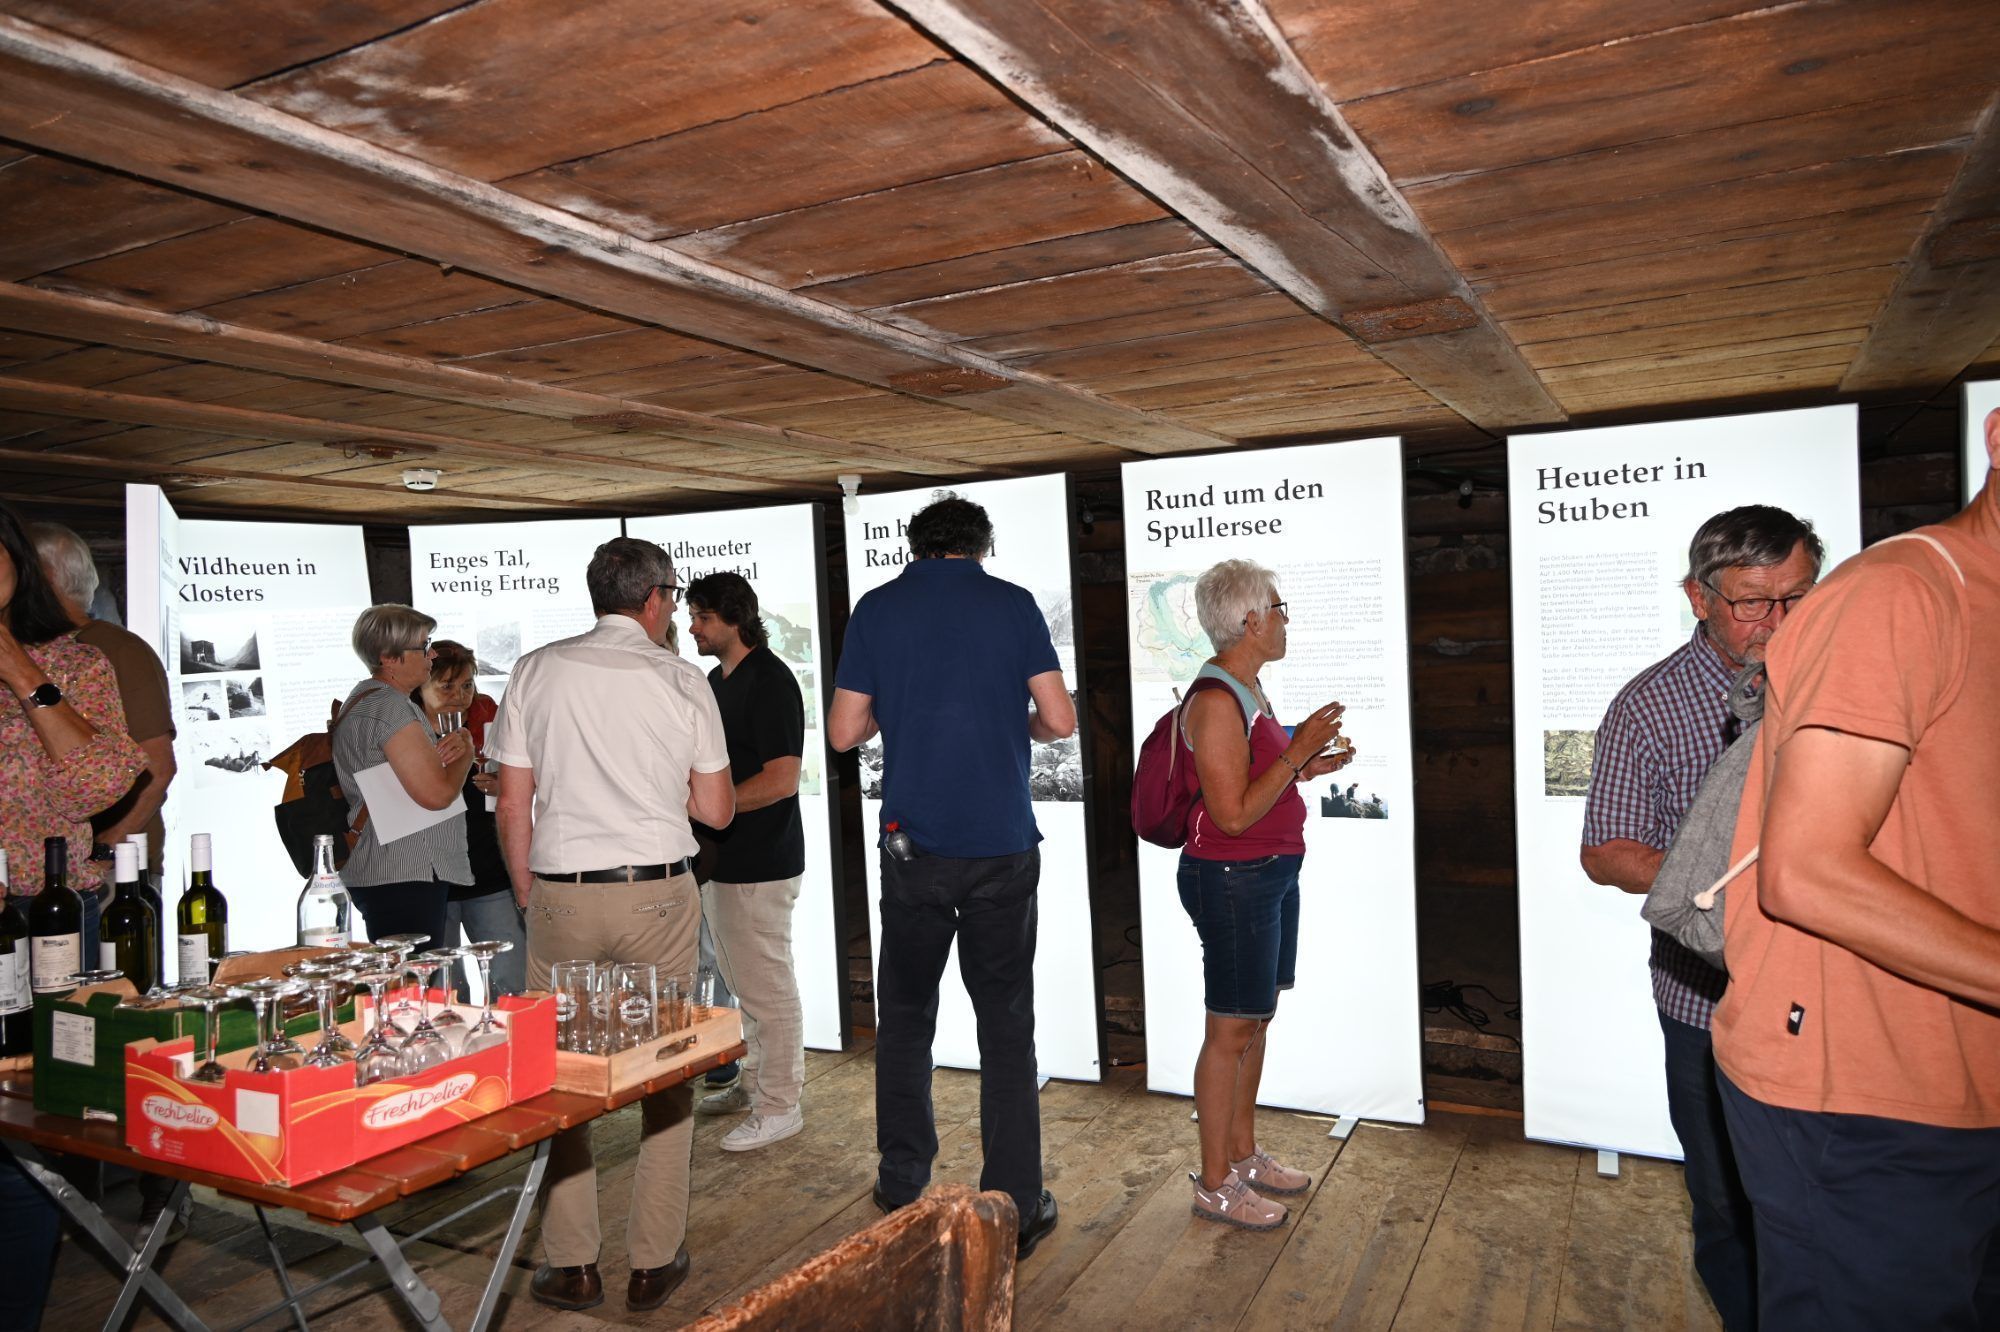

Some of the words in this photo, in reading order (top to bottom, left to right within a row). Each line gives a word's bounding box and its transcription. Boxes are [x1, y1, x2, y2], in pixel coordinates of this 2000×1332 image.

[1536, 463, 1664, 490] Heueter
[1674, 456, 1708, 480] in
[1146, 485, 1215, 511] Rund
[1223, 487, 1266, 505] um
[1274, 478, 1325, 501] den
[1538, 497, 1650, 524] Stuben
[863, 522, 890, 540] Im
[1147, 516, 1282, 547] Spullersee
[430, 552, 488, 573] Enges
[494, 549, 530, 568] Tal,
[657, 540, 752, 559] ldheueter
[296, 558, 317, 575] in
[431, 575, 493, 597] wenig
[499, 574, 560, 595] Ertrag
[144, 1098, 214, 1126] FreshDelice
[366, 1081, 469, 1125] FreshDelice
